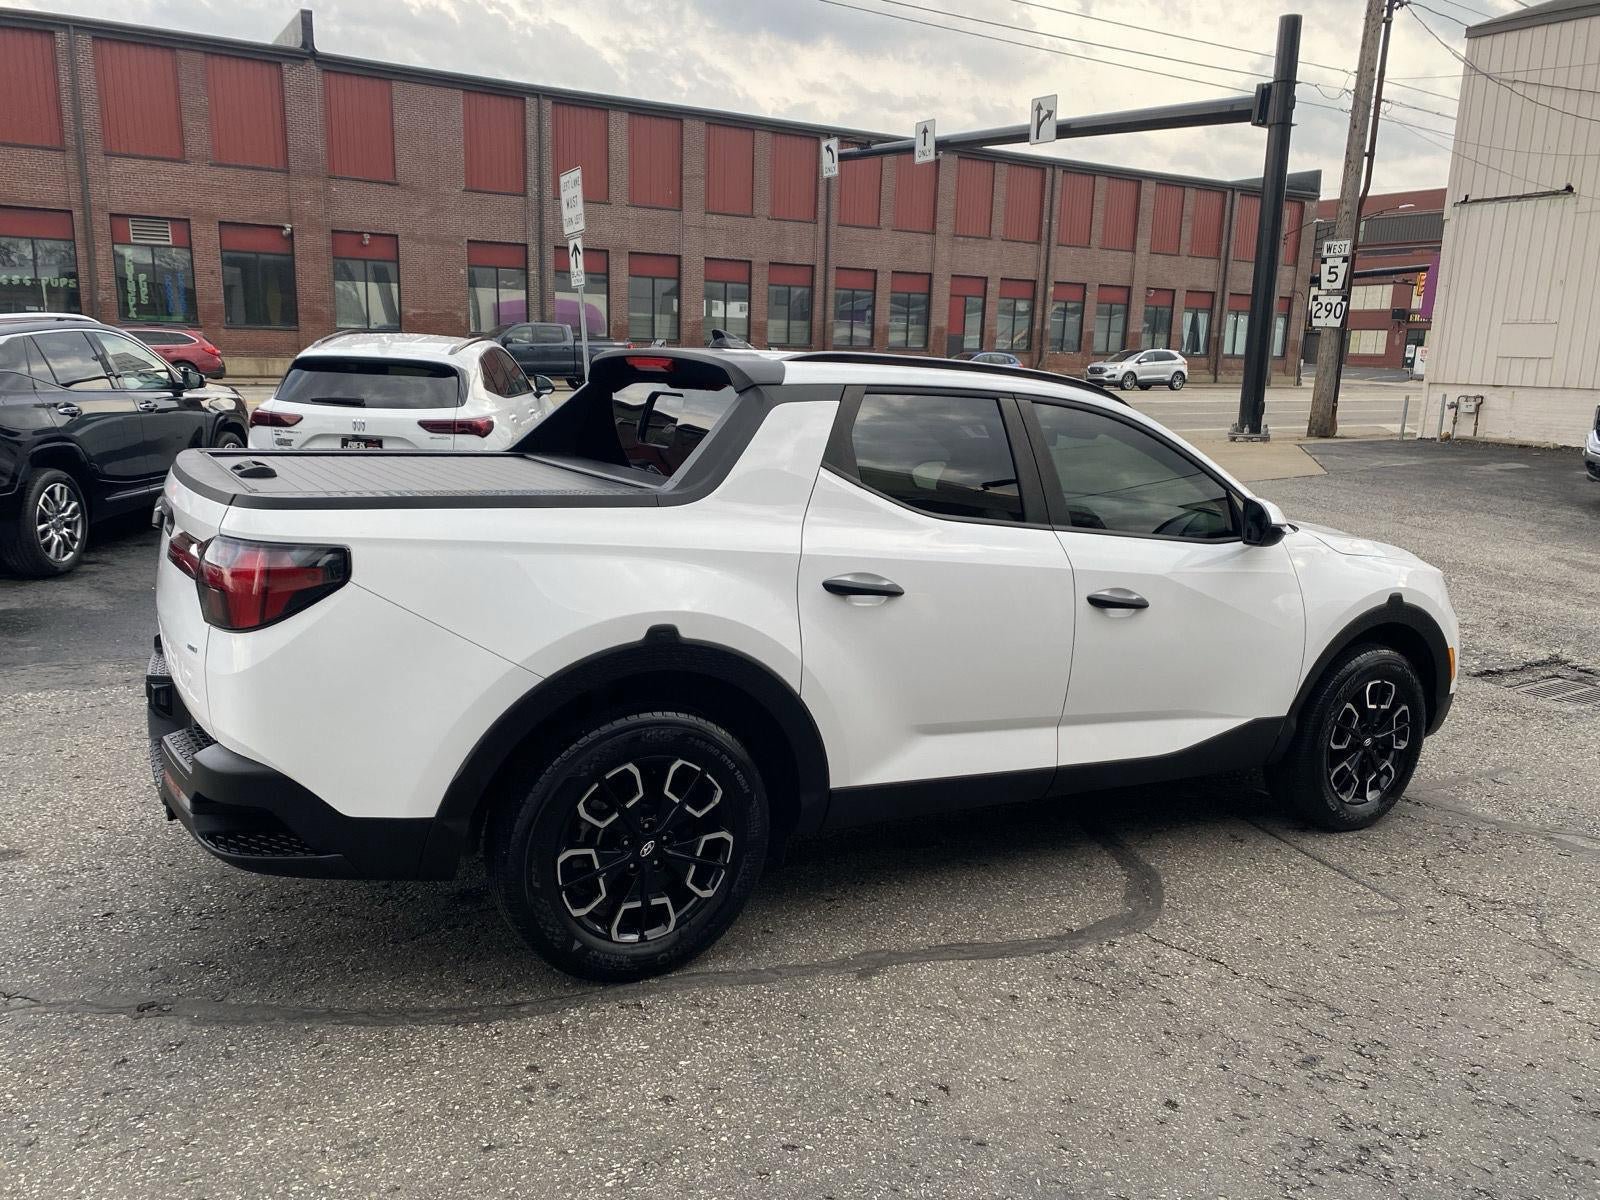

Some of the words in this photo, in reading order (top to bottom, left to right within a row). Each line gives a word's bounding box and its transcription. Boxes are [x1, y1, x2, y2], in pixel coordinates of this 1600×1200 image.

[918, 148, 931, 158] ONLY
[825, 166, 836, 175] ONLY
[562, 180, 570, 192] LEFT
[571, 176, 581, 190] LANE
[566, 195, 578, 210] MUST
[564, 217, 574, 227] TURN
[574, 213, 583, 225] LEFT
[1326, 243, 1348, 254] WEST
[1326, 265, 1338, 283] 5
[1313, 302, 1343, 320] 290
